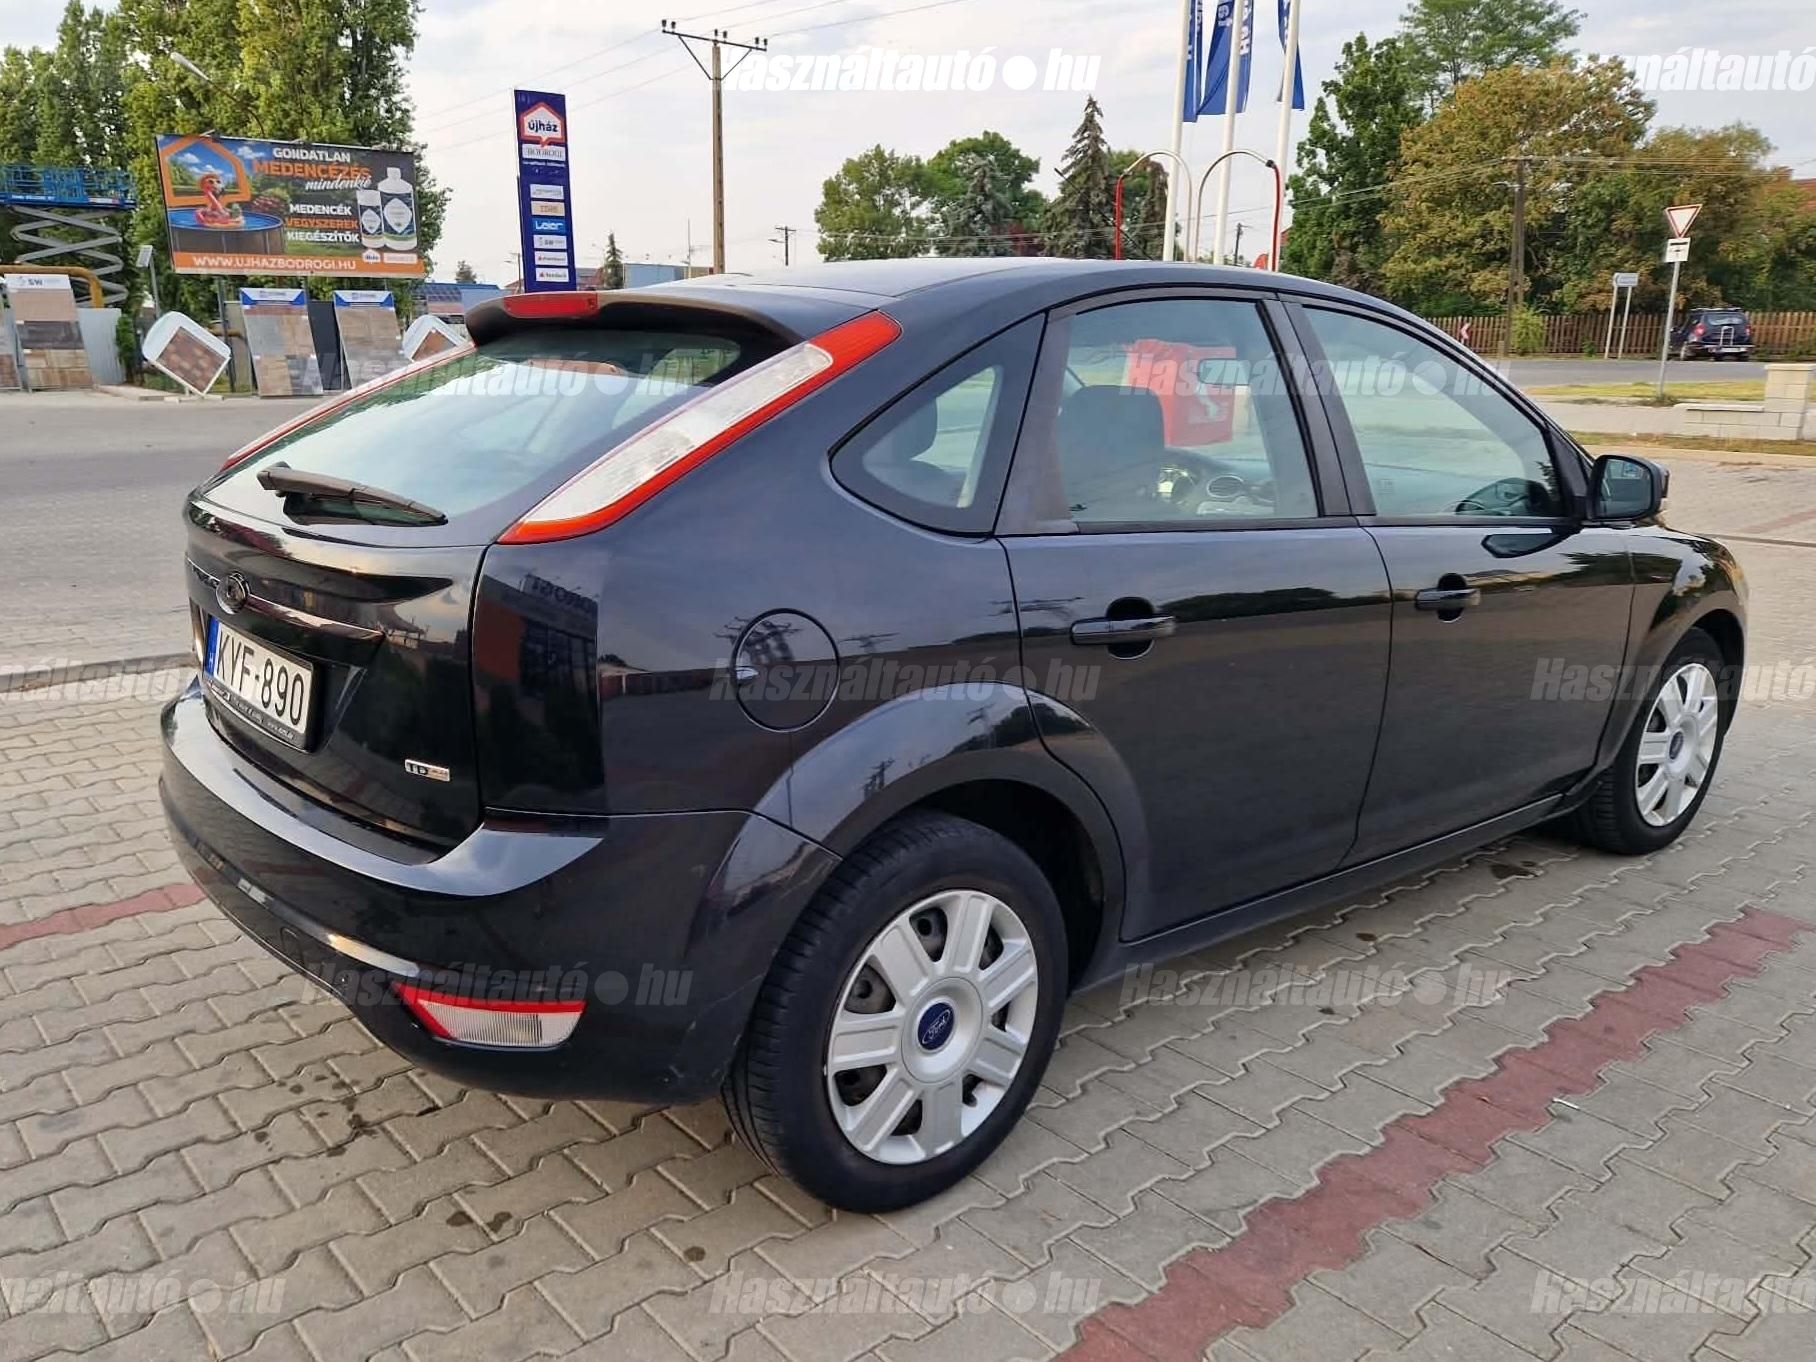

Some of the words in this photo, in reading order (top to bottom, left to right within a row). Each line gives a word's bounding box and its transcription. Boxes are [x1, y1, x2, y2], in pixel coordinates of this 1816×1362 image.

[272, 147, 352, 163] GONDATLAN
[253, 159, 371, 180] MEDENCÉZÉS
[289, 203, 353, 216] MEDENCÉK
[287, 217, 361, 230] VEGYSZEREK
[217, 629, 305, 727] KYF-890
